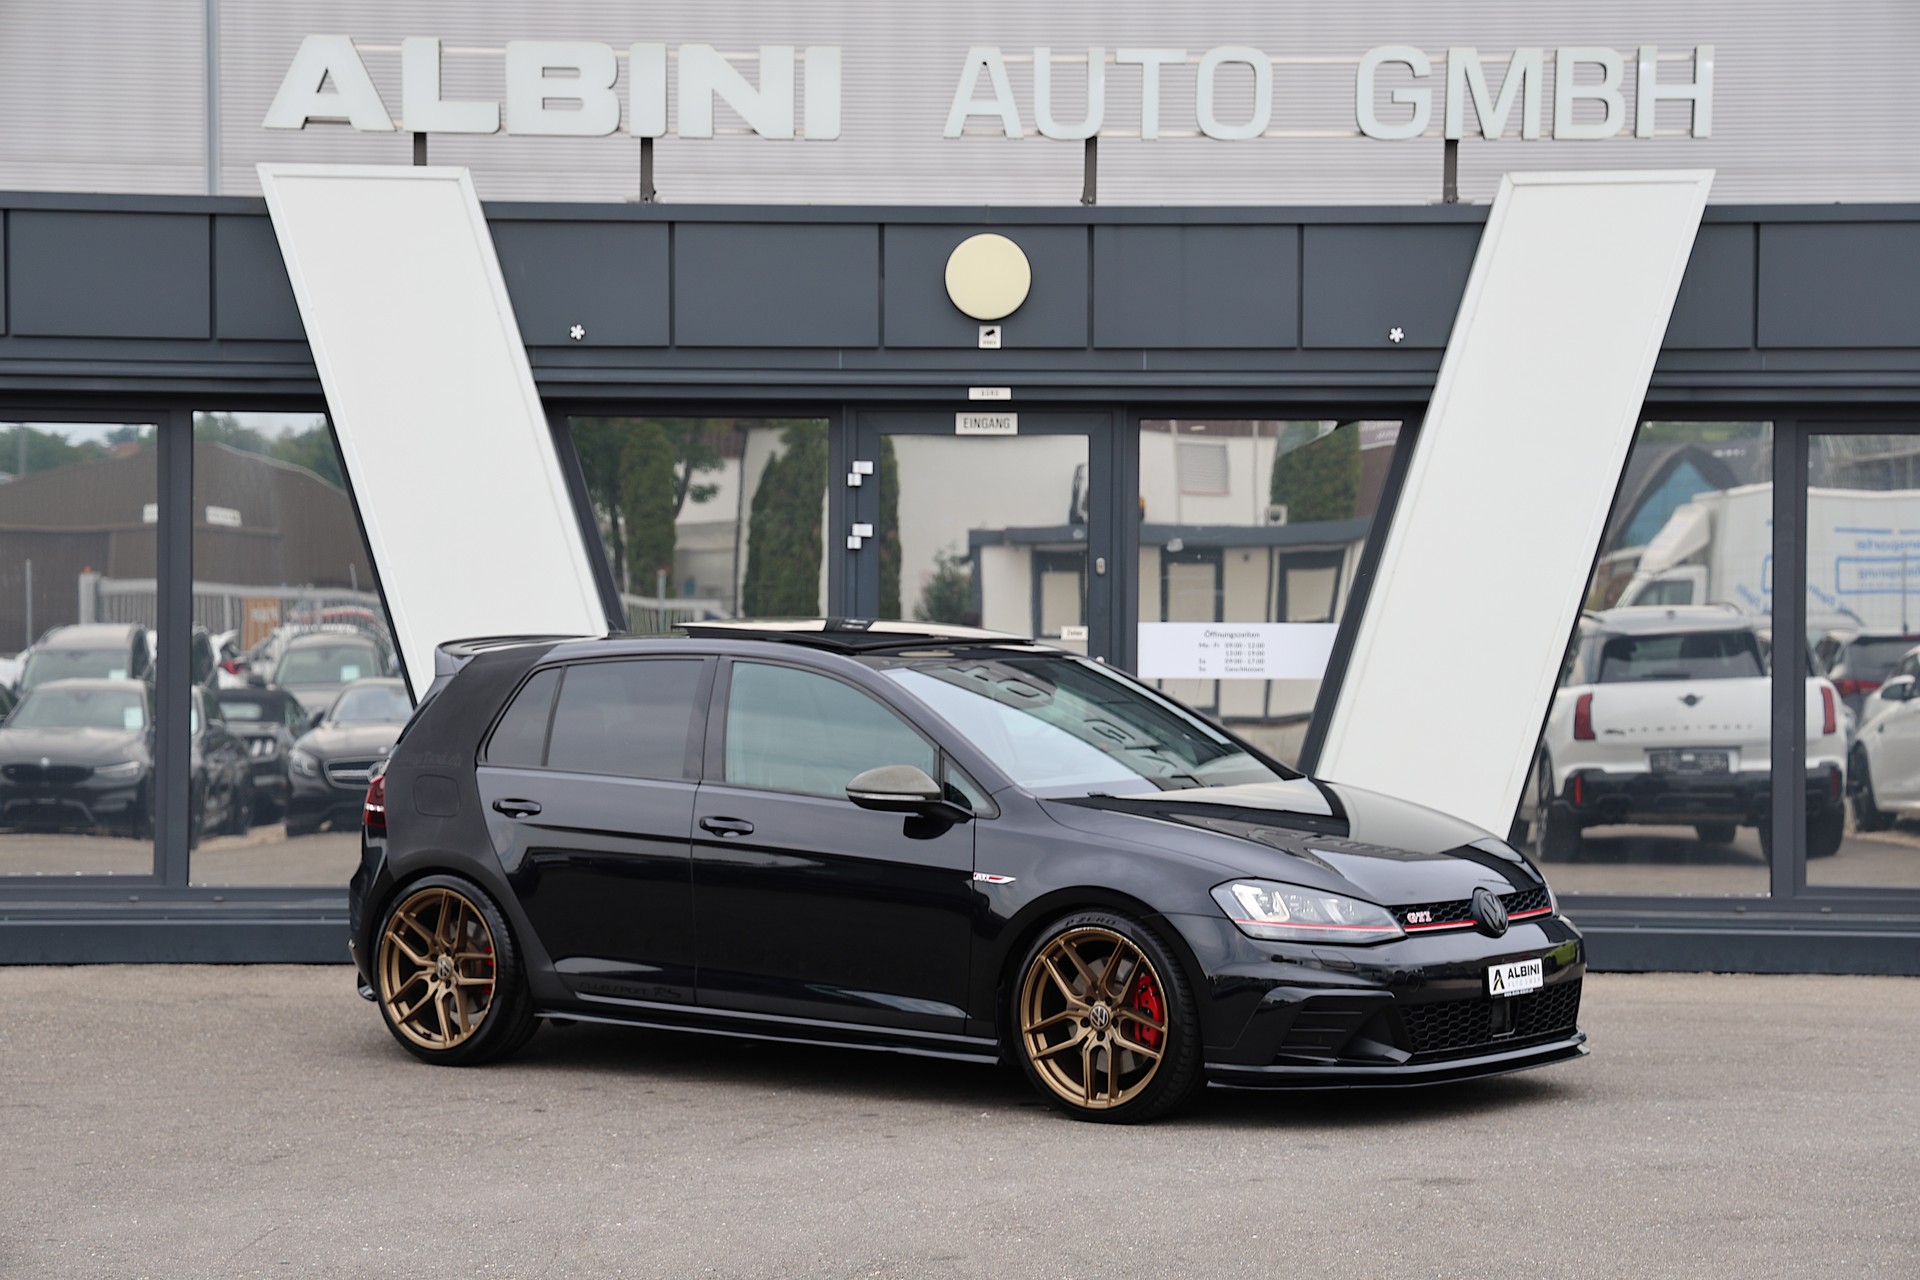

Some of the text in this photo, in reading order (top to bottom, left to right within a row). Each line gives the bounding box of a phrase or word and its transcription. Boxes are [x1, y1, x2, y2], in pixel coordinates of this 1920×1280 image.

[262, 34, 1715, 141] ALBINI AUTO GMBH
[963, 417, 1010, 430] EINGANG
[1204, 630, 1260, 638] Öffnungszeiten
[1406, 911, 1432, 924] GTI
[1508, 963, 1540, 980] ALBINI
